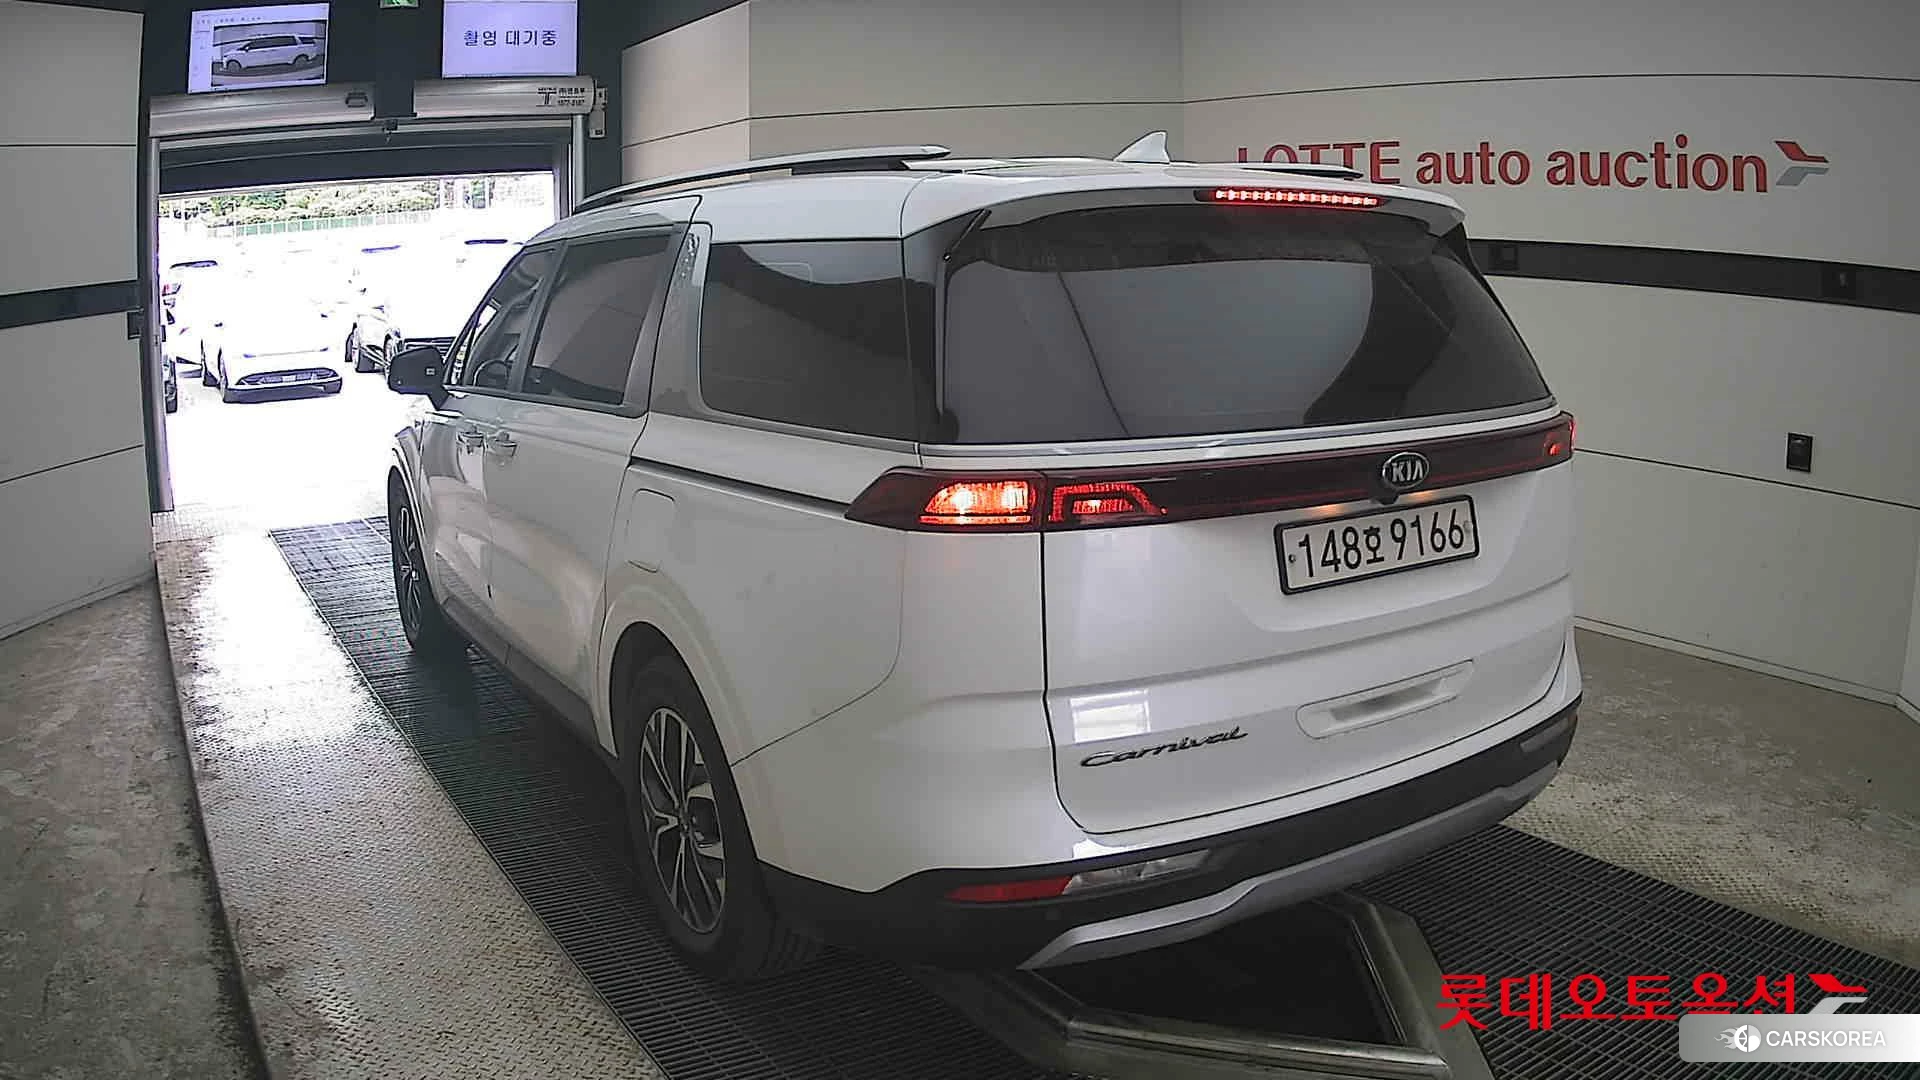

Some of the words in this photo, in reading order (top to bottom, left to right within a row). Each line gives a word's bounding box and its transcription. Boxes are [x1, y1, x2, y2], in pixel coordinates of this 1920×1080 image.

[505, 30, 556, 46] 대기중
[1416, 141, 1531, 185] auto
[1546, 133, 1768, 193] auction
[1391, 460, 1424, 483] KIA
[1080, 726, 1249, 768] Carnival
